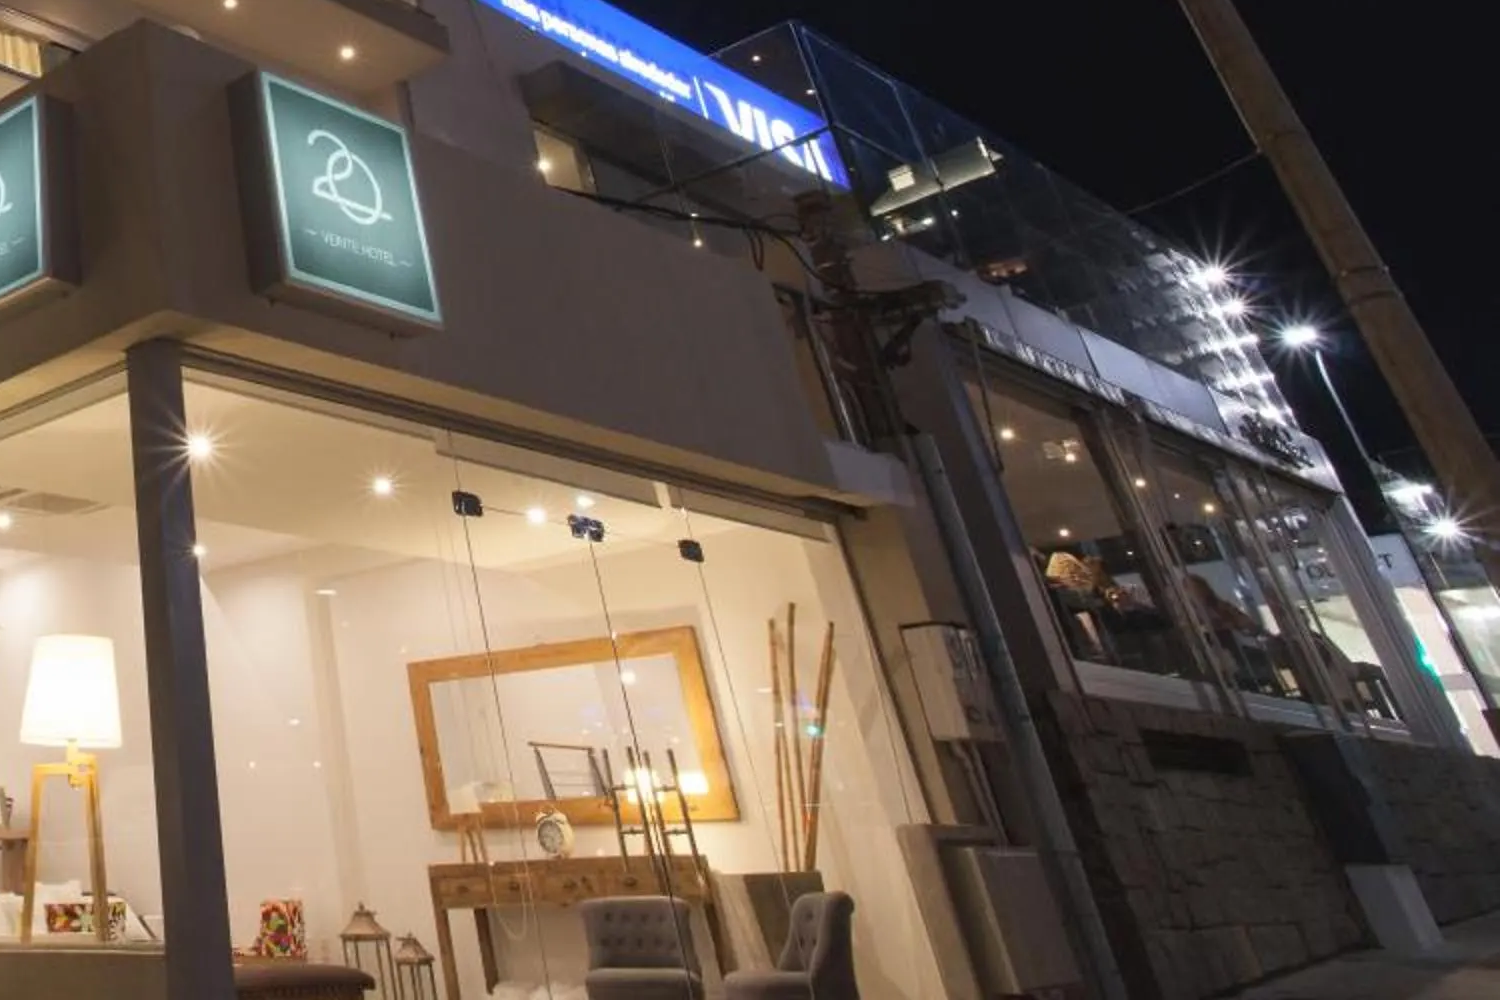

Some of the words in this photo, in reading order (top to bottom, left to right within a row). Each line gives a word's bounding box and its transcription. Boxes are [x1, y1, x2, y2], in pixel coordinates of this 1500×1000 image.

[307, 129, 393, 225] 20
[703, 81, 833, 182] VISA
[361, 244, 397, 267] HOTEL
